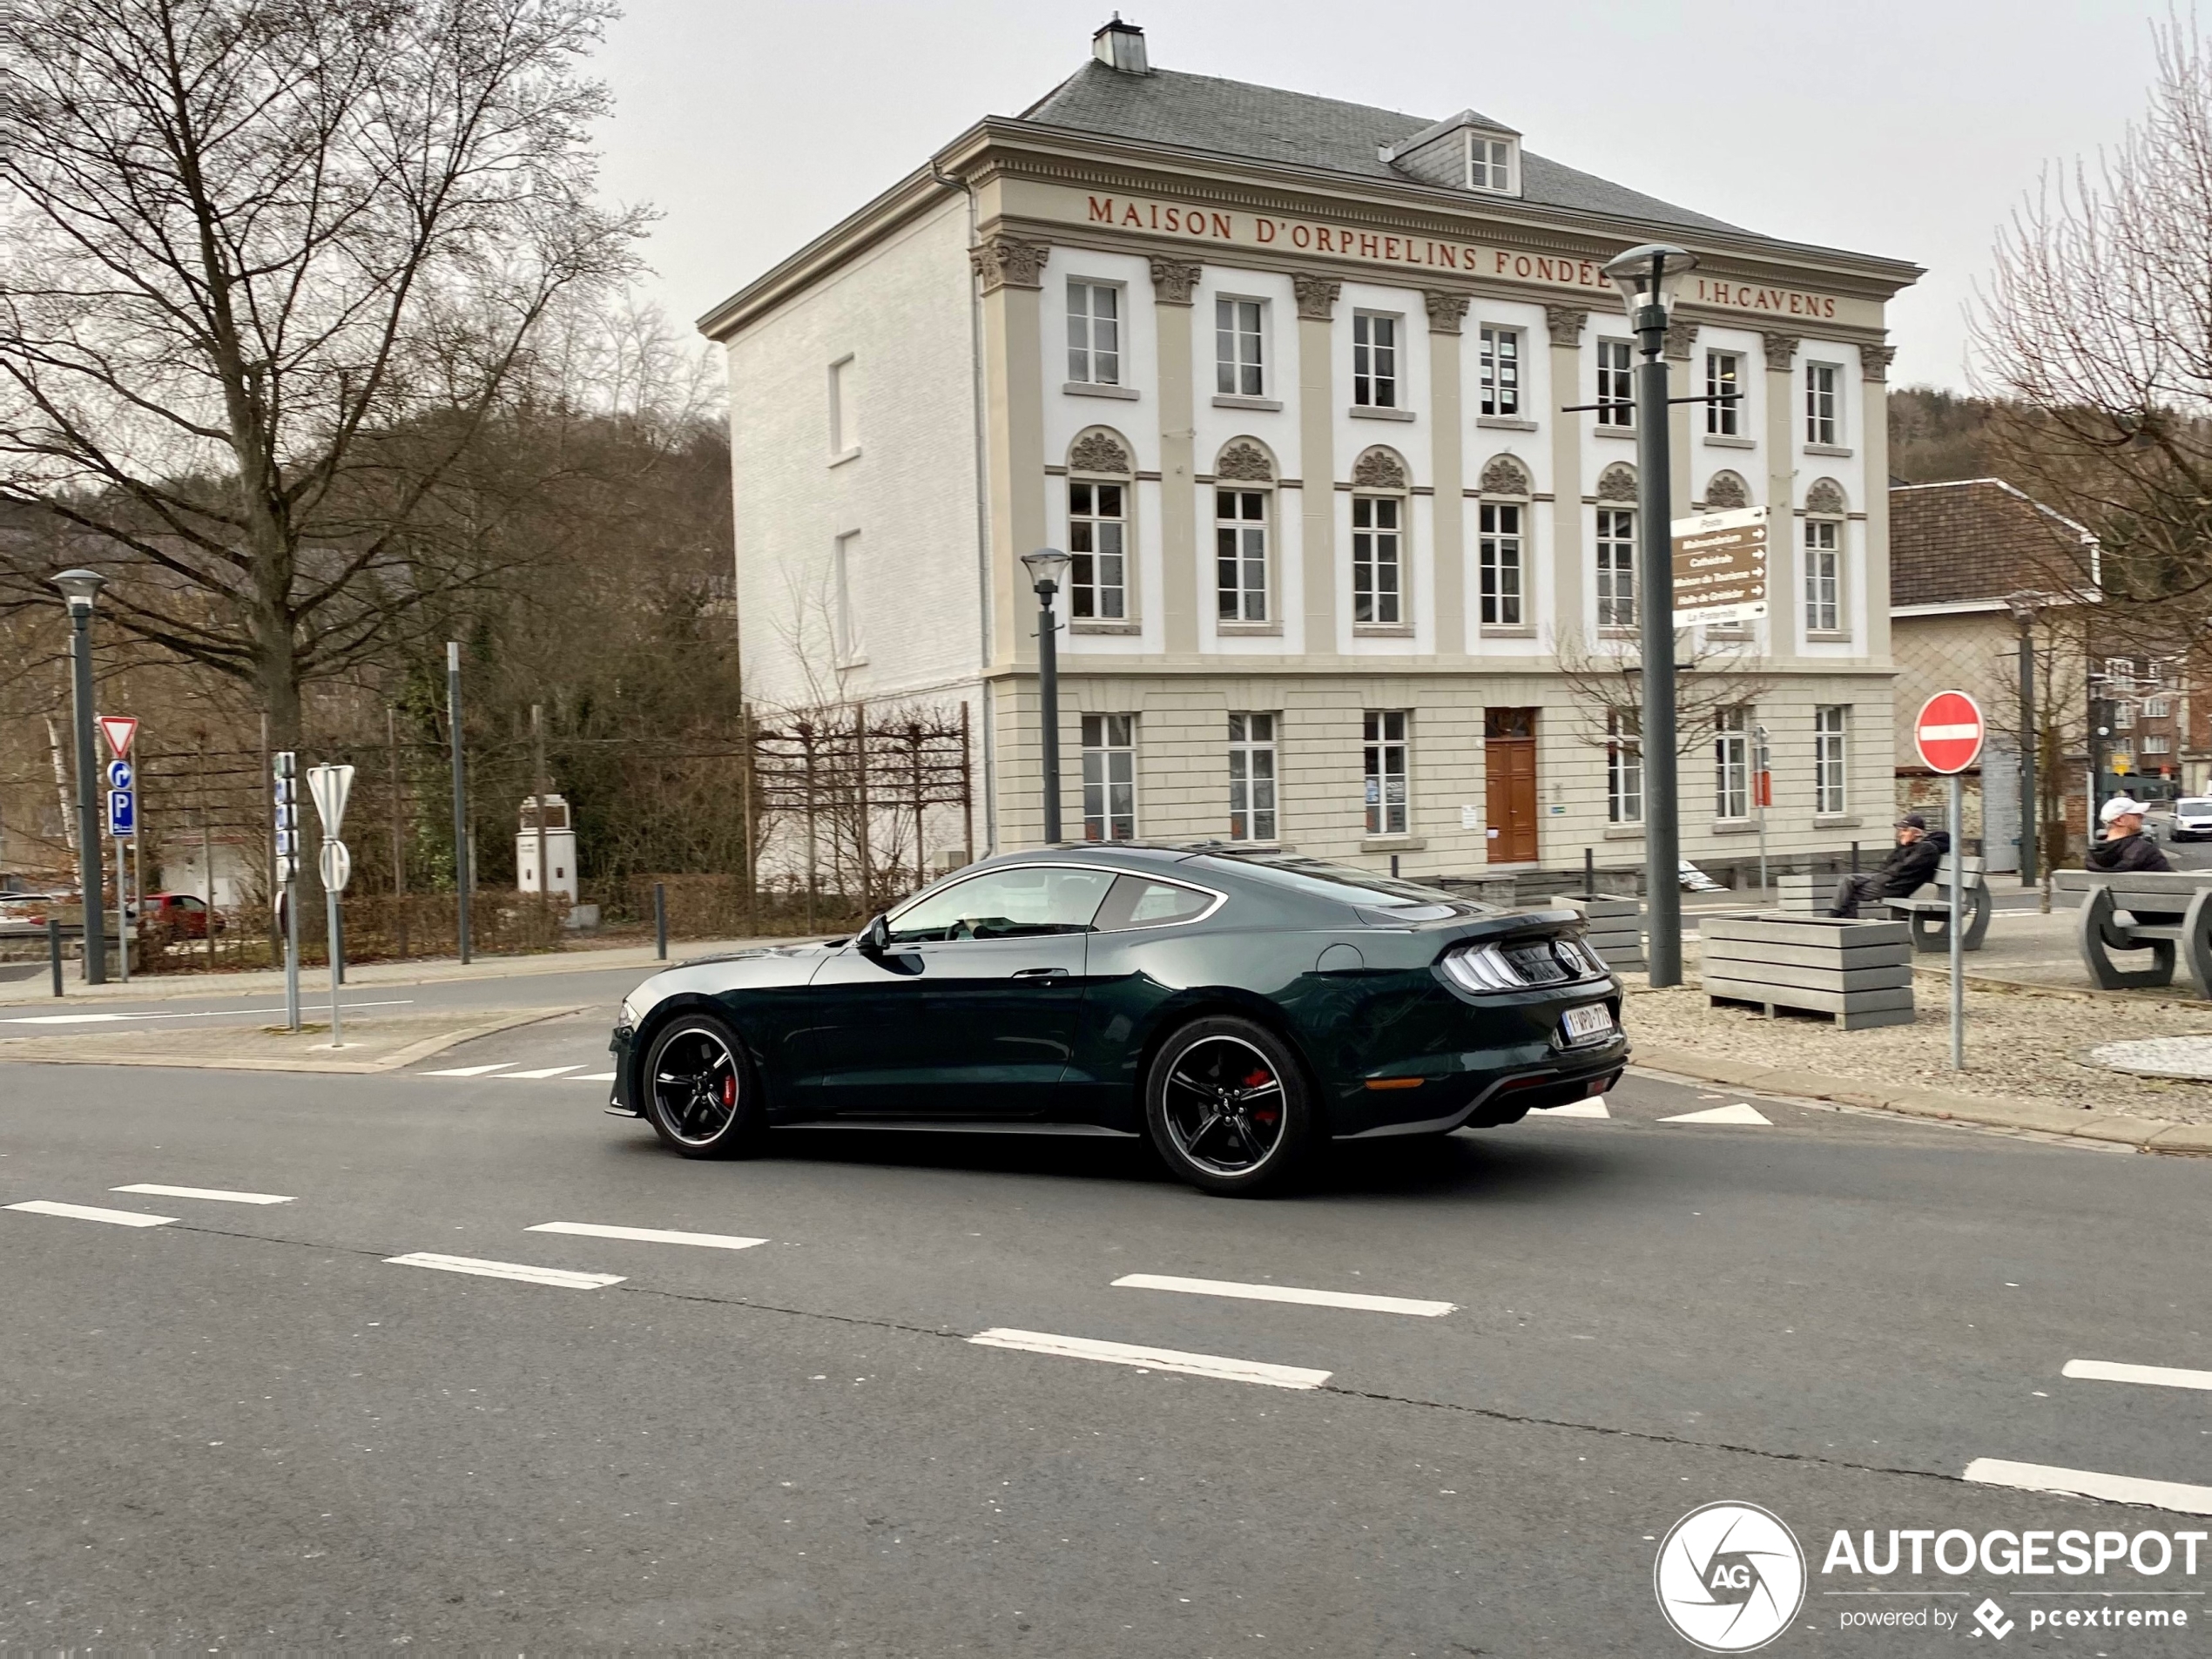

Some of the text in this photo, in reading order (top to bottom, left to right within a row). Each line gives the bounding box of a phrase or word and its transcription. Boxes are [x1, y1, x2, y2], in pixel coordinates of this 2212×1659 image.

[1089, 196, 1231, 239] MAISON
[1256, 219, 1476, 270] D'ORPHELINS
[114, 793, 129, 818] P
